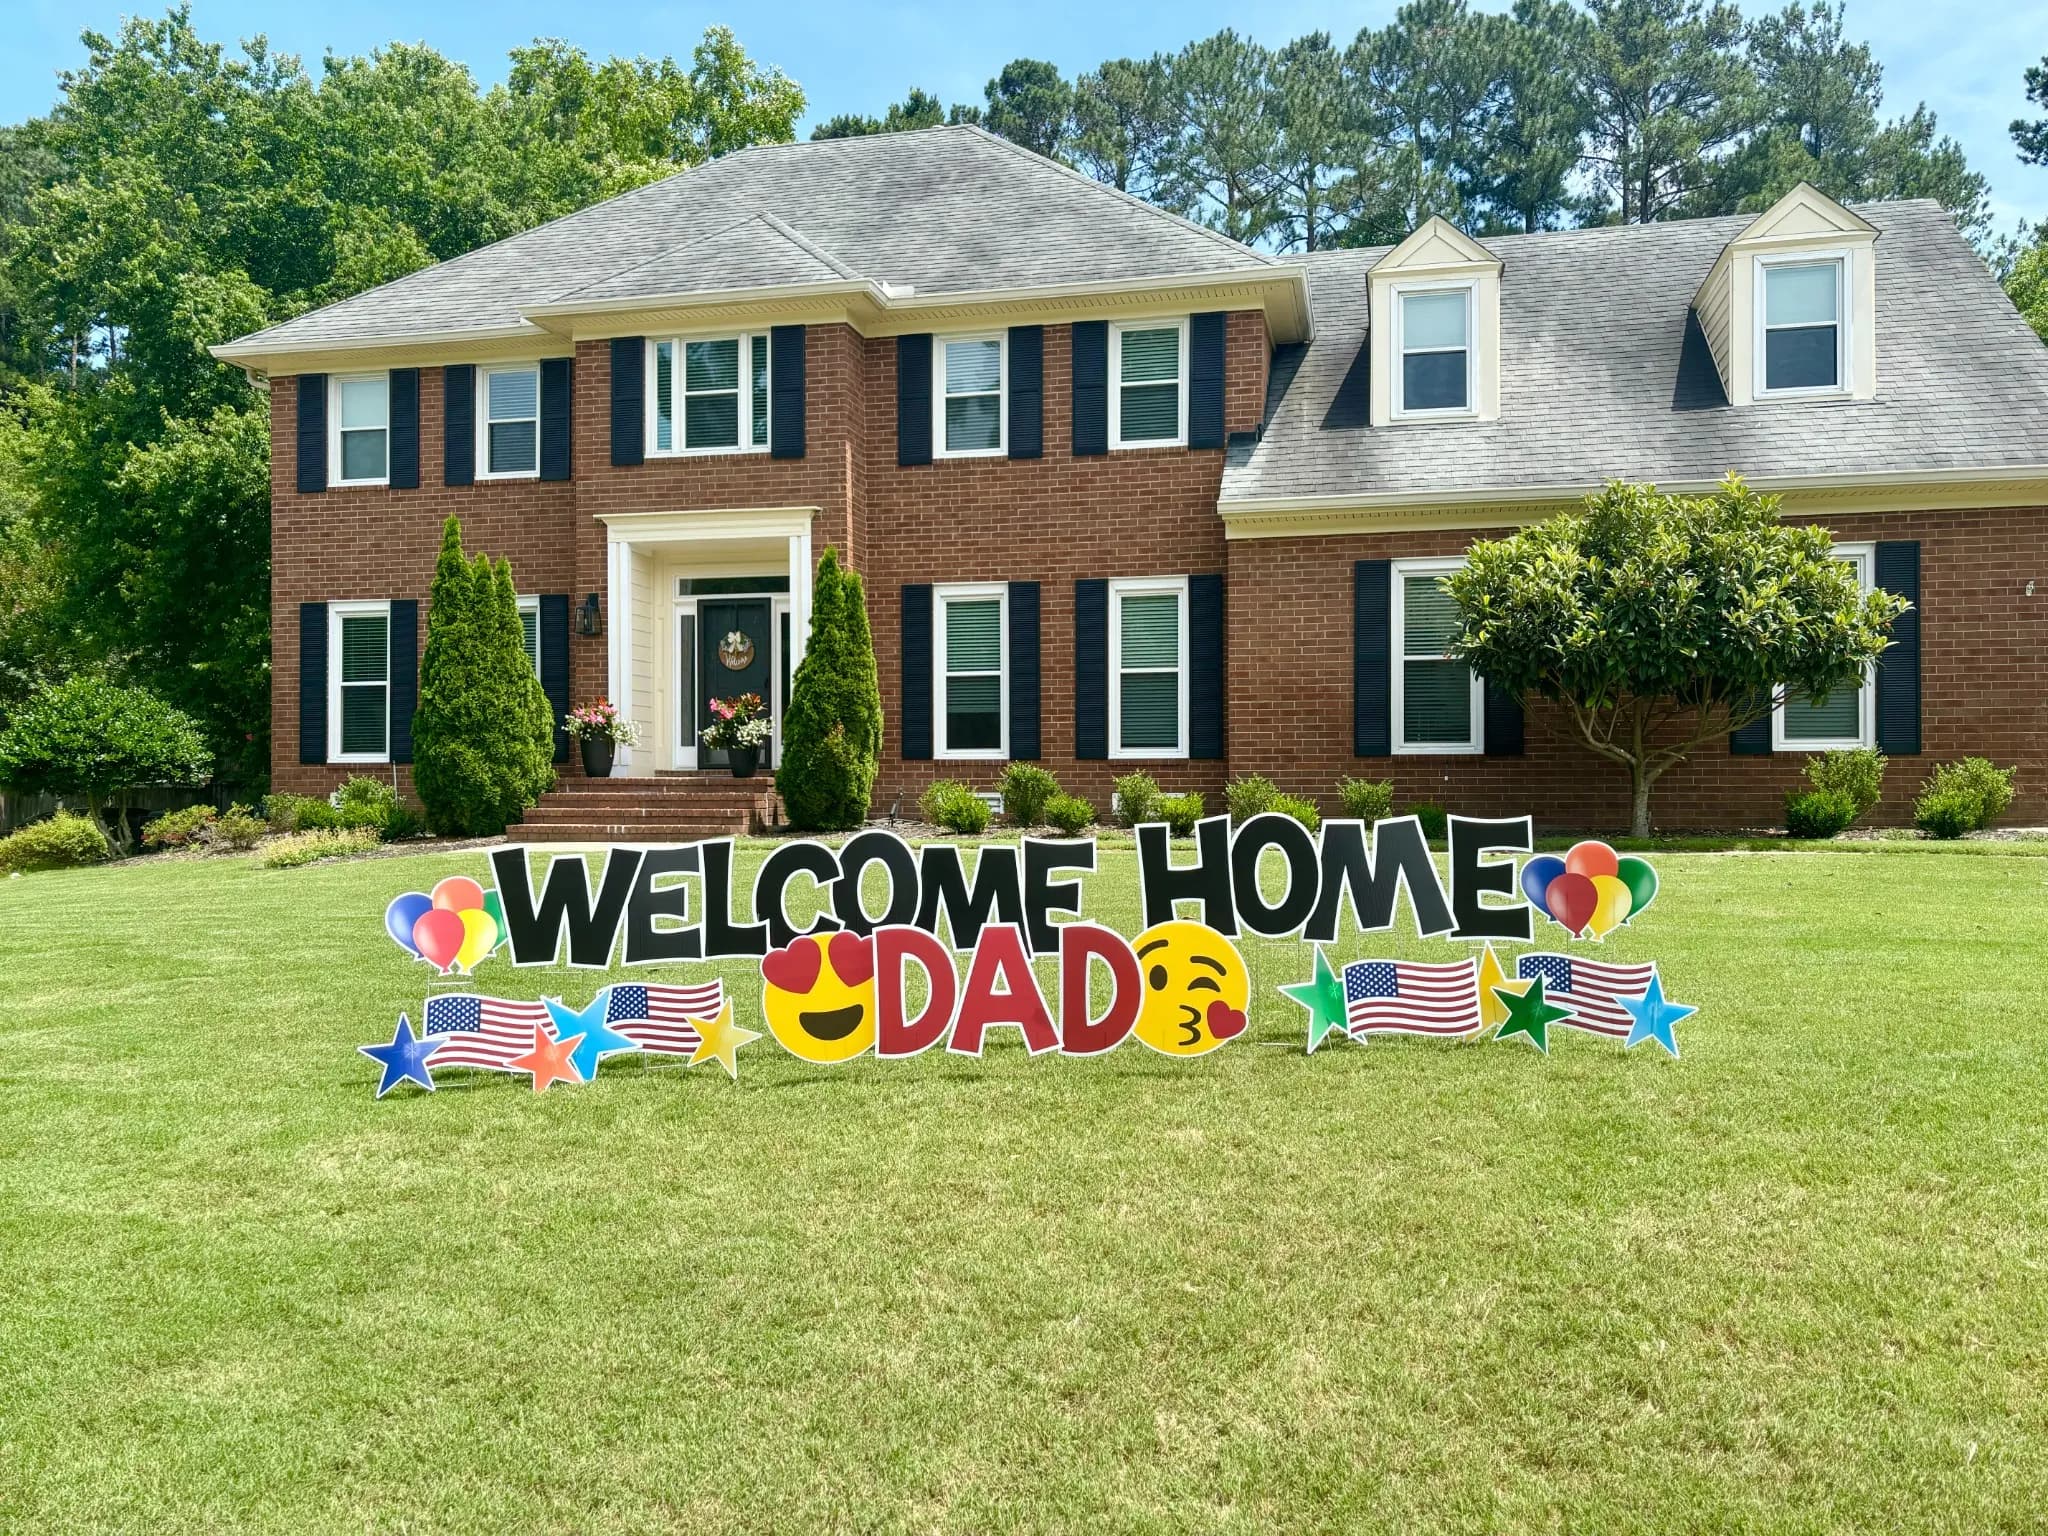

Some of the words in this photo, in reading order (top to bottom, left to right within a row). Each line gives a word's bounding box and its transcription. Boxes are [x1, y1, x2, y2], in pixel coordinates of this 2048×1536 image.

[489, 831, 1096, 968] WELCOME
[1136, 813, 1533, 942] HOME
[873, 922, 1143, 1056] DAD
